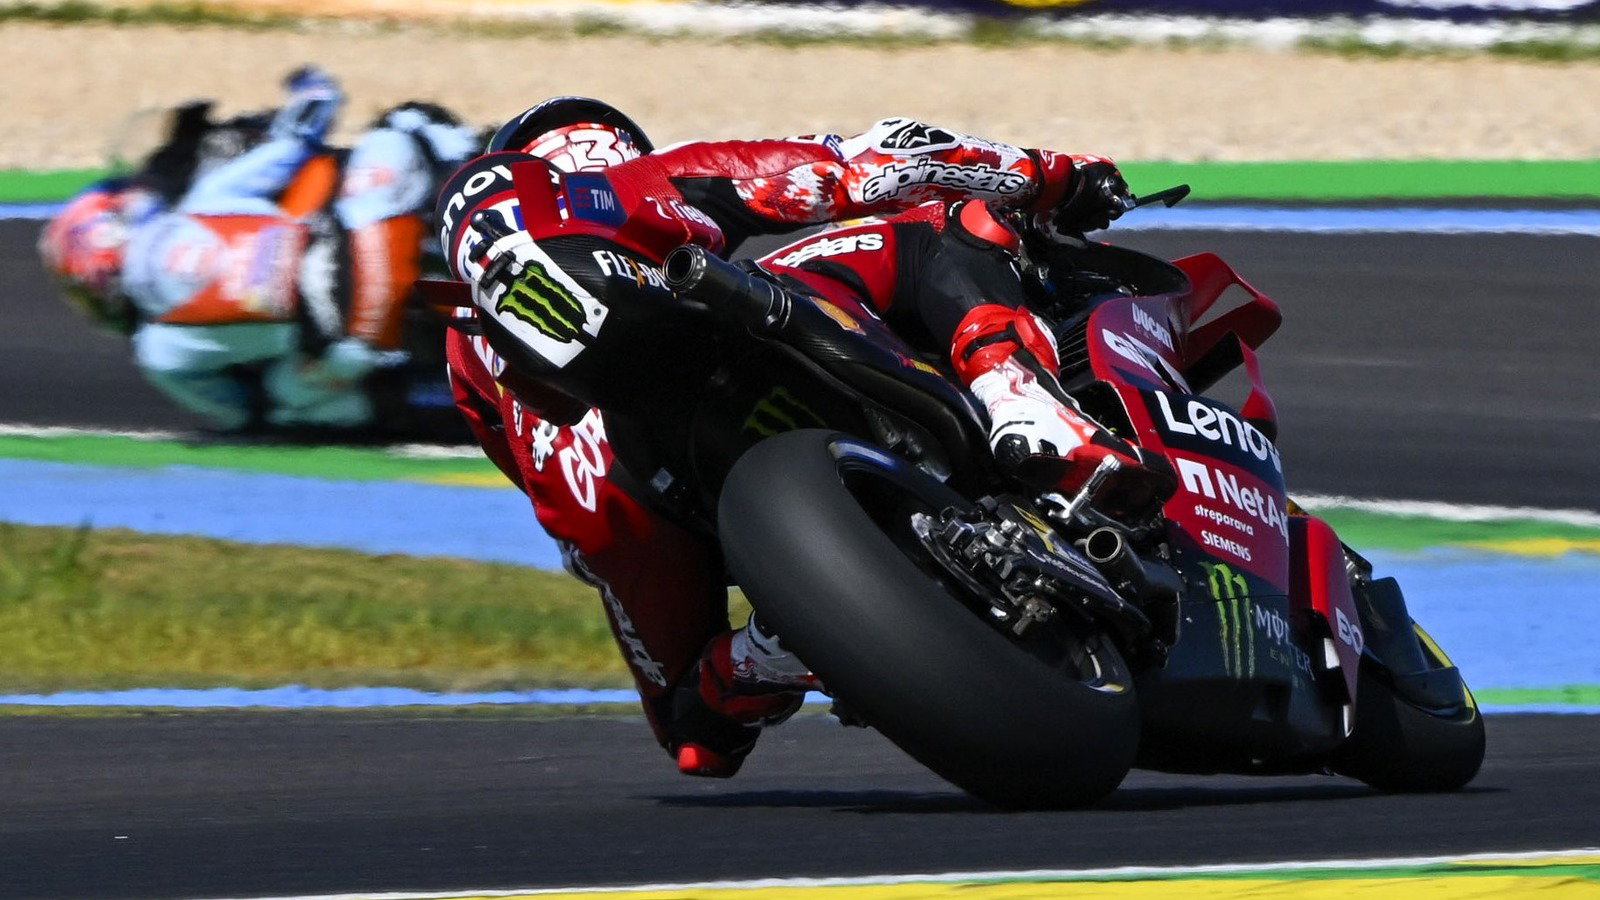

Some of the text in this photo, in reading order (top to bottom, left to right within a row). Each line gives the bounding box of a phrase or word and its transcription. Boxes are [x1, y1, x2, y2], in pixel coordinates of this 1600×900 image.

[863, 158, 1027, 203] alpinestars
[590, 188, 615, 211] TIM
[592, 250, 671, 291] FLEX-BO
[1154, 390, 1282, 474] Lenov
[1194, 504, 1254, 536] streparava
[1201, 530, 1252, 562] SIEMENS
